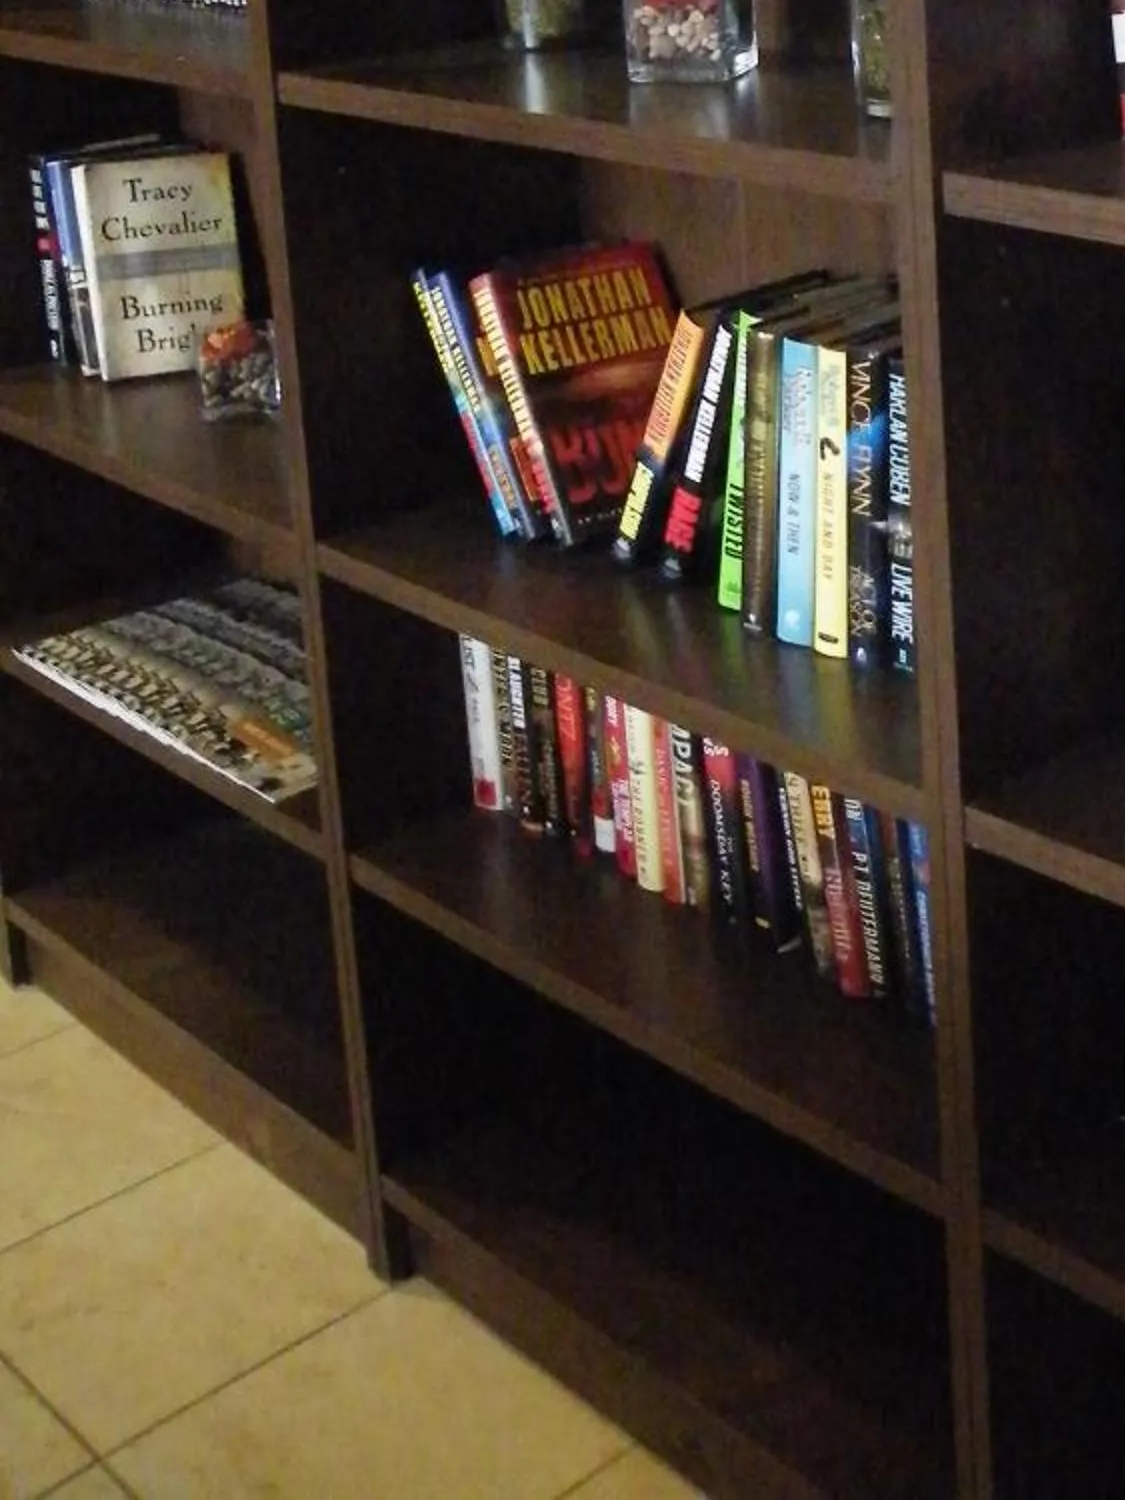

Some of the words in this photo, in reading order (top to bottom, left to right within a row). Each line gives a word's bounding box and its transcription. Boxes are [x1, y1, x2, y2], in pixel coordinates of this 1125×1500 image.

[123, 178, 193, 203] Tracy
[101, 212, 223, 242] Chevalier
[121, 294, 224, 320] Burning
[517, 267, 652, 330] JONATHAN
[137, 324, 197, 353] Brig
[519, 306, 672, 376] KELLERMAN
[702, 325, 733, 402] JONATHAN
[851, 361, 872, 432] VINCE
[889, 373, 911, 448] HARLAN
[684, 399, 717, 483] KELLERMAN
[786, 473, 800, 501] NOW
[822, 473, 835, 514] NIGHT
[851, 444, 873, 517] FLYNN
[890, 444, 912, 506] COBEN
[664, 485, 702, 554] RAGE
[786, 520, 800, 554] THEN
[822, 519, 834, 551] AND
[822, 555, 834, 581] DAY
[890, 562, 913, 596] LIVE
[891, 600, 913, 644] WIRE
[709, 779, 729, 862] DOOMSDAY
